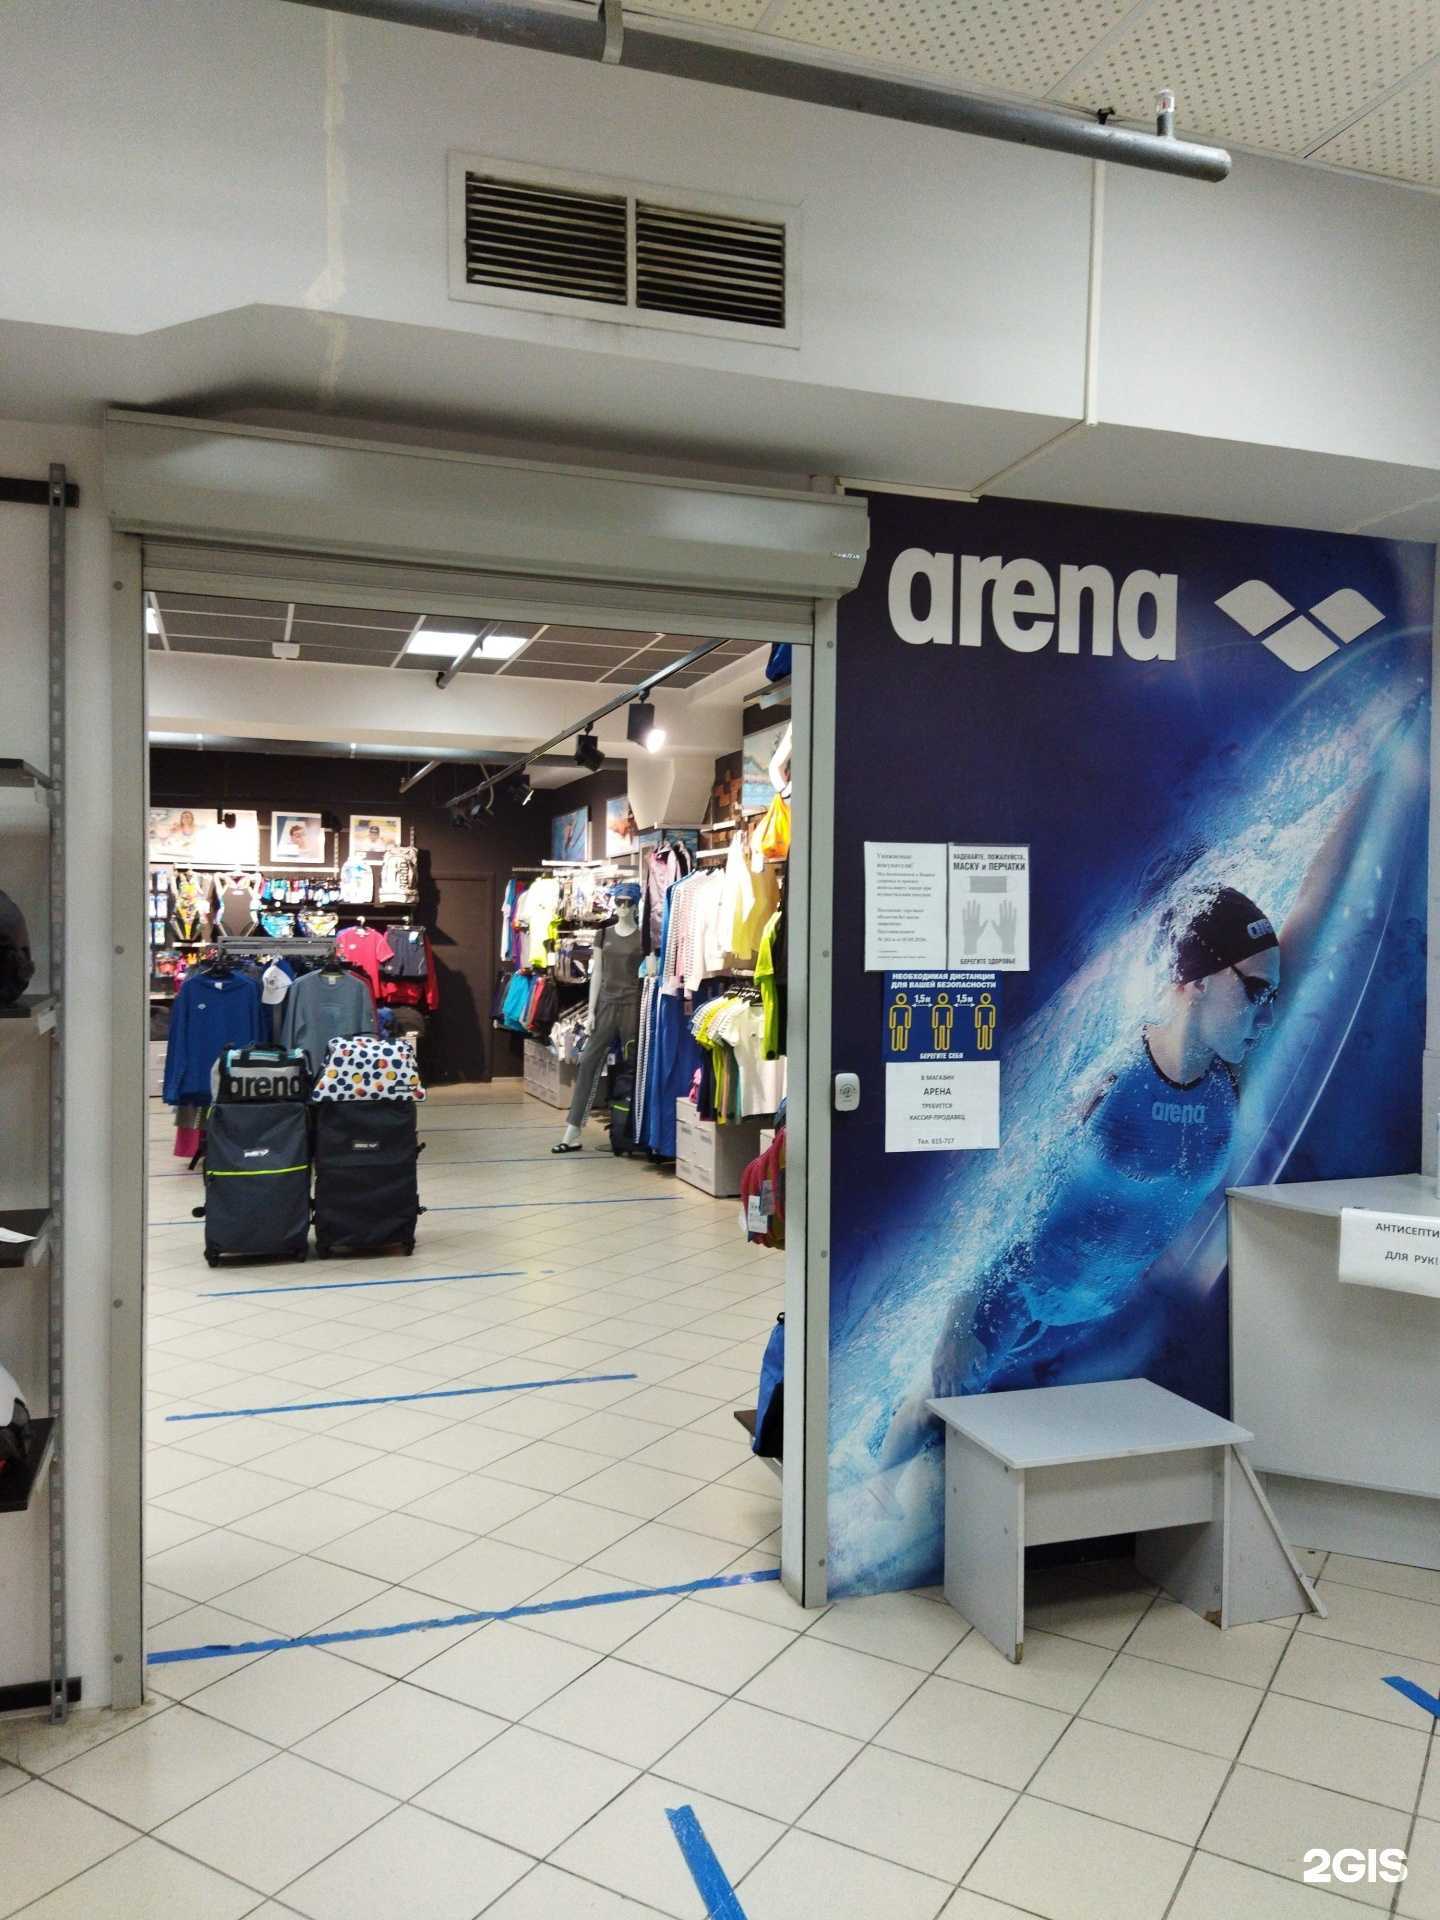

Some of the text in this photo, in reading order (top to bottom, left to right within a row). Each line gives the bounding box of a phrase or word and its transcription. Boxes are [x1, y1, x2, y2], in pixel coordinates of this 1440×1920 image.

[888, 547, 1179, 662] arena
[953, 862, 979, 870] МАСКУ
[989, 862, 1026, 871] ПЕРЧАТКИ
[892, 973, 996, 981] НЕОБХОДИМАЯ ДИСТАНЦИЯ
[891, 981, 908, 989] ДЛЯ
[923, 1087, 952, 1096] АРЕНА
[1152, 1102, 1205, 1124] arena
[1384, 1251, 1409, 1262] ДЛЯ
